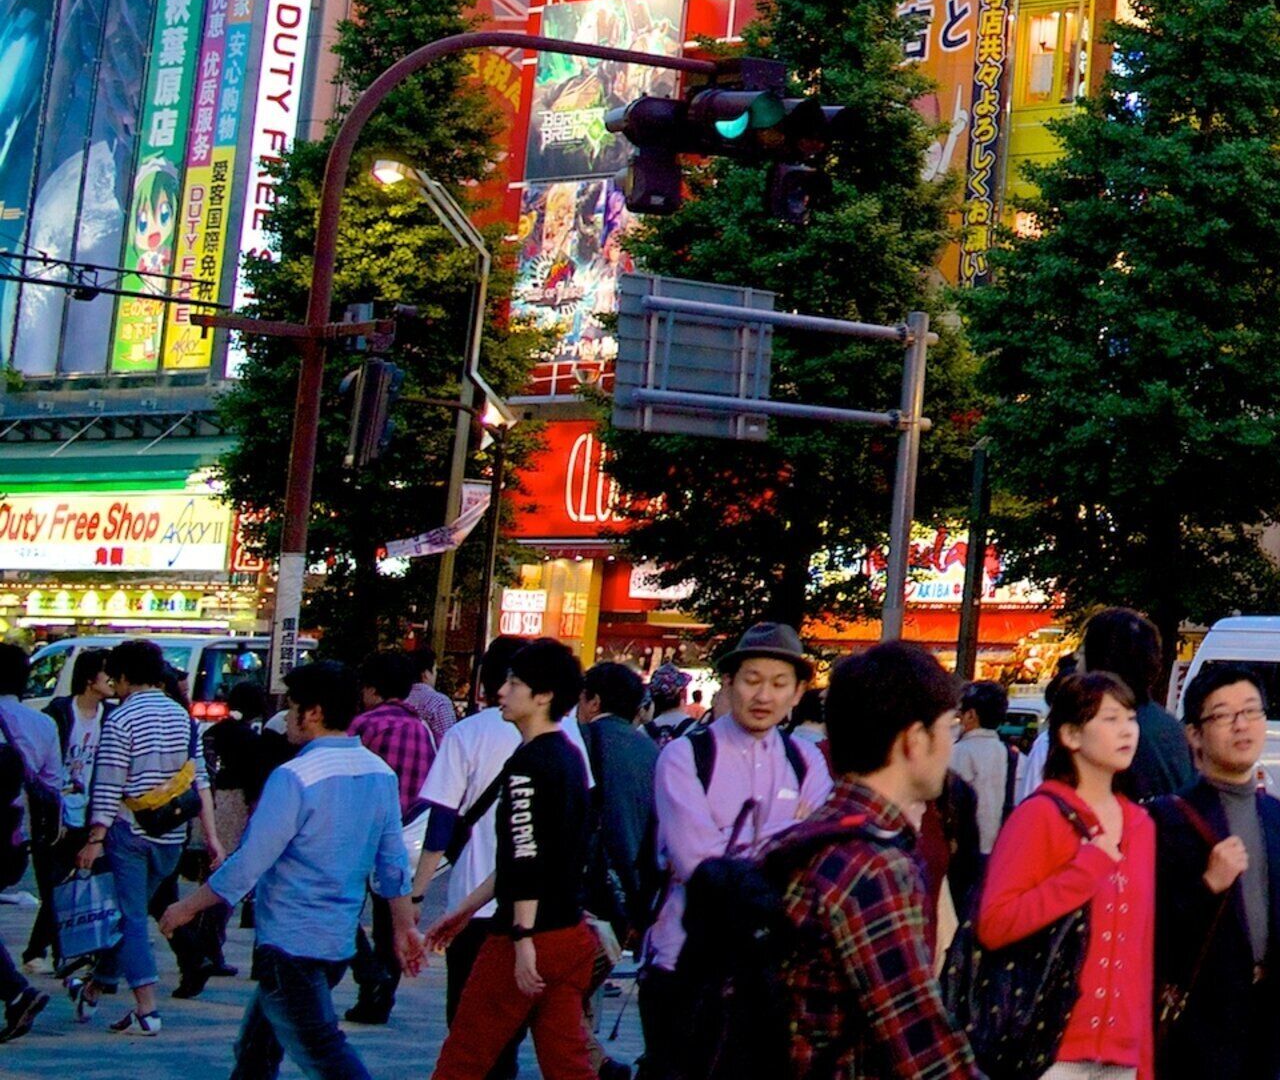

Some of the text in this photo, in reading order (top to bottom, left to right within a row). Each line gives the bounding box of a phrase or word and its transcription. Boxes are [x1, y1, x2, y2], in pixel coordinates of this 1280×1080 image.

[266, 3, 302, 113] DUTY
[184, 185, 206, 251] DUTY
[49, 503, 100, 541] Free
[103, 502, 161, 542] Shop
[917, 583, 950, 598] AKIBA
